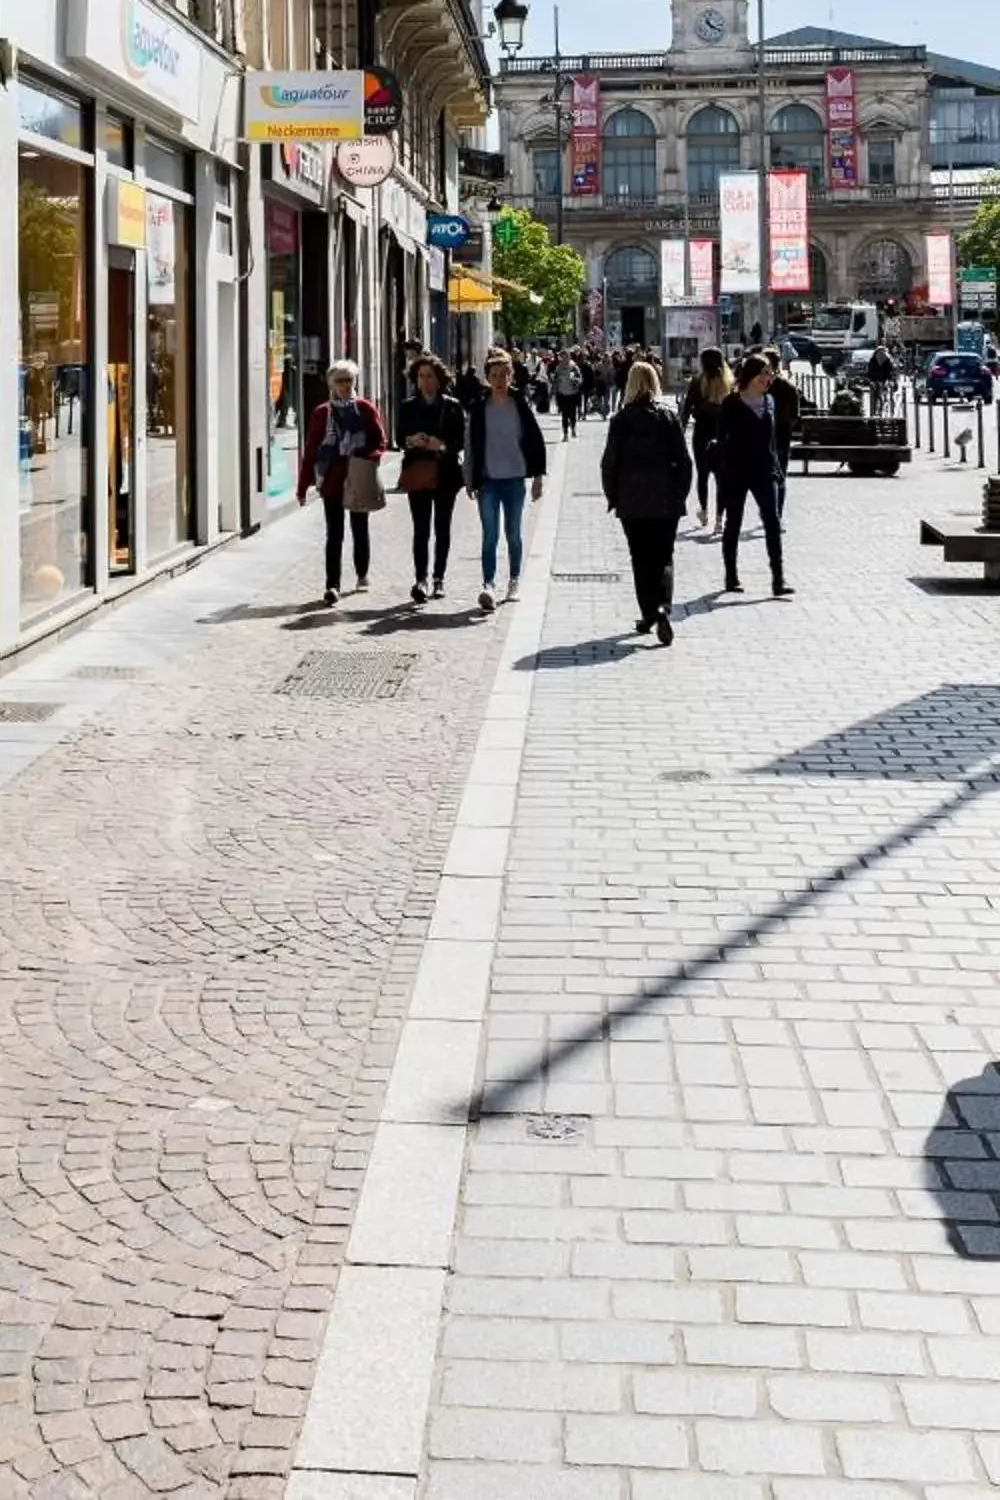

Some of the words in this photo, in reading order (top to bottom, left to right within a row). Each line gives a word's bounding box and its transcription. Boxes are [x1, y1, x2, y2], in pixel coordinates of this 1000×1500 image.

[280, 84, 352, 103] aquatour
[267, 124, 341, 138] Neckermann
[431, 221, 467, 235] ATOL
